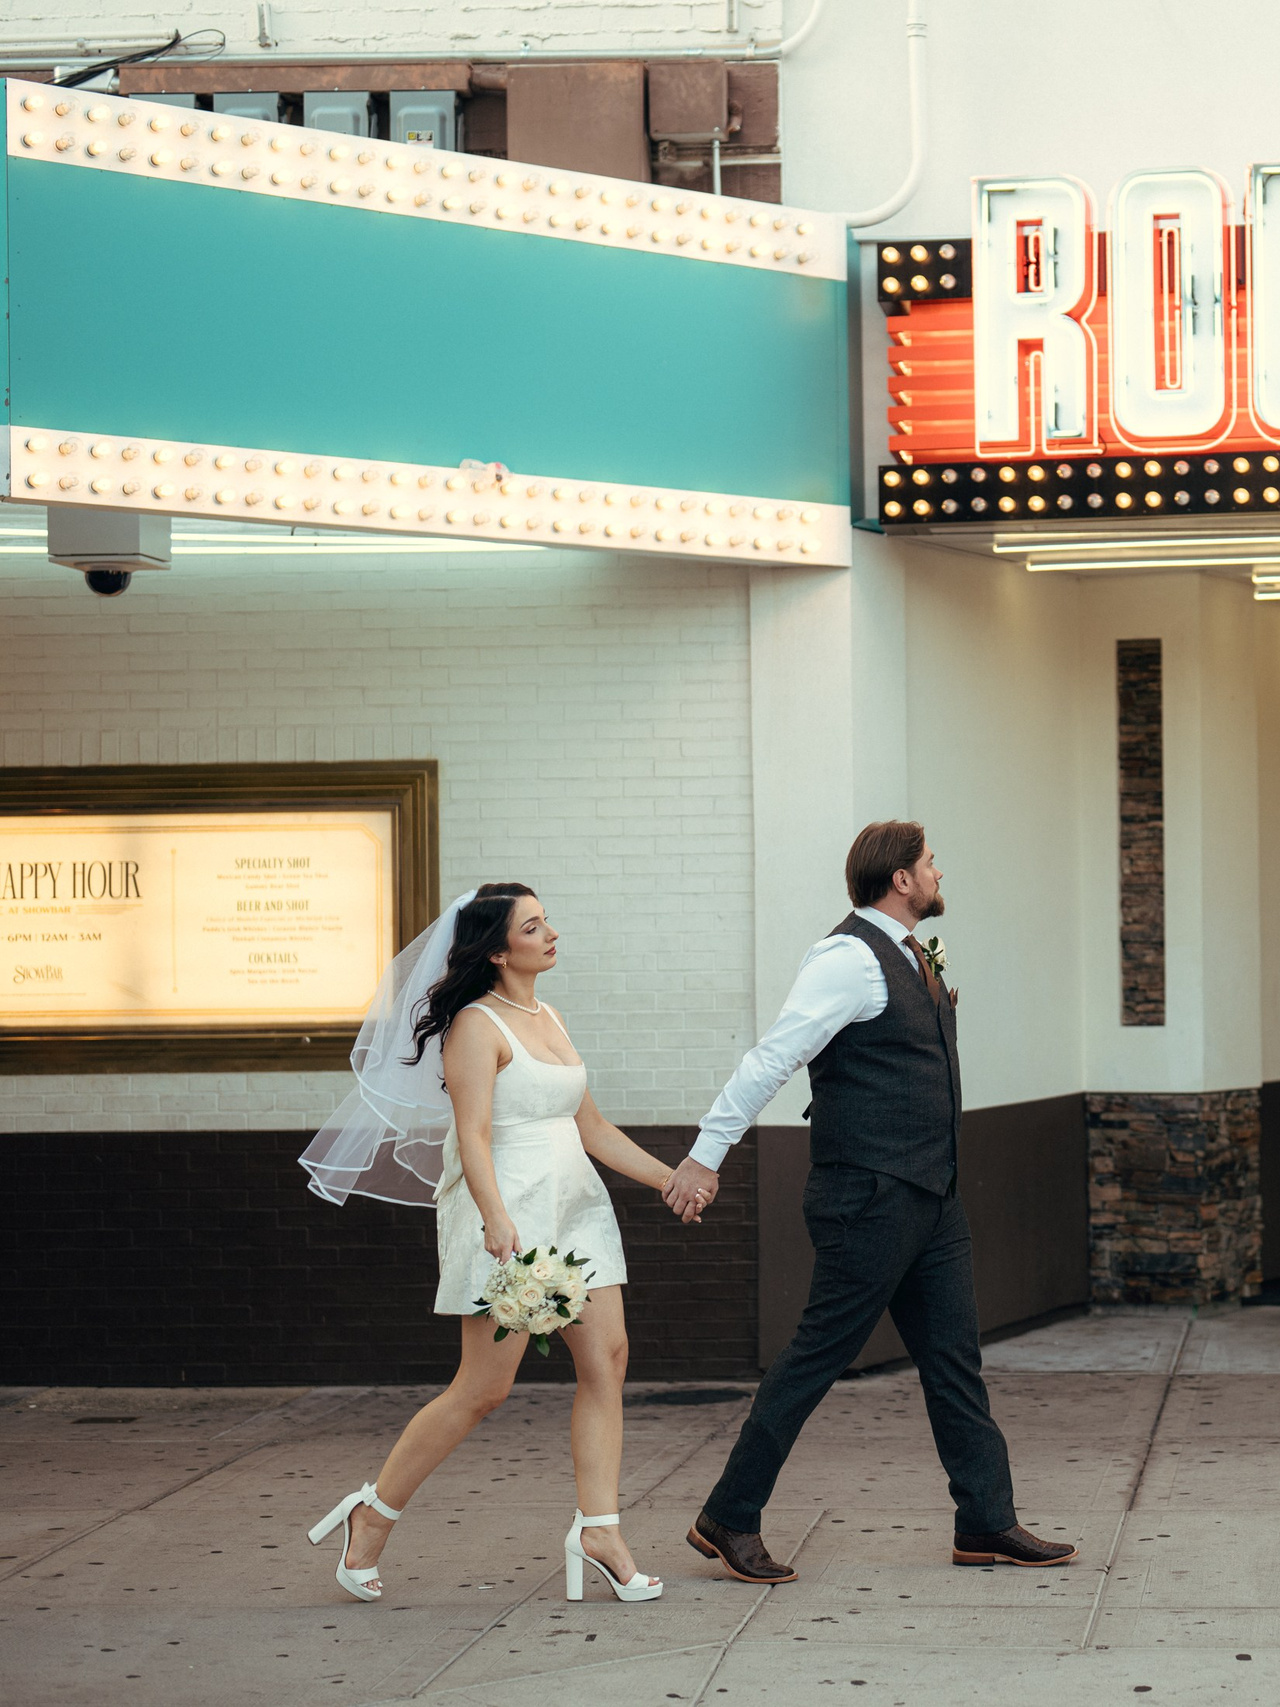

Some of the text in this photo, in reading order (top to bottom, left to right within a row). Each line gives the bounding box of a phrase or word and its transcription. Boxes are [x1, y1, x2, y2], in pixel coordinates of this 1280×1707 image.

[235, 857, 311, 869] SPECIALTY SHOT
[0, 861, 143, 900] APPY HOUR
[8, 905, 72, 915] AT SHOWBAR
[236, 899, 310, 912] BEER AND SHOT
[7, 933, 32, 942] 6PM
[41, 933, 68, 942] 12AM
[248, 952, 298, 964] COCKTAILS
